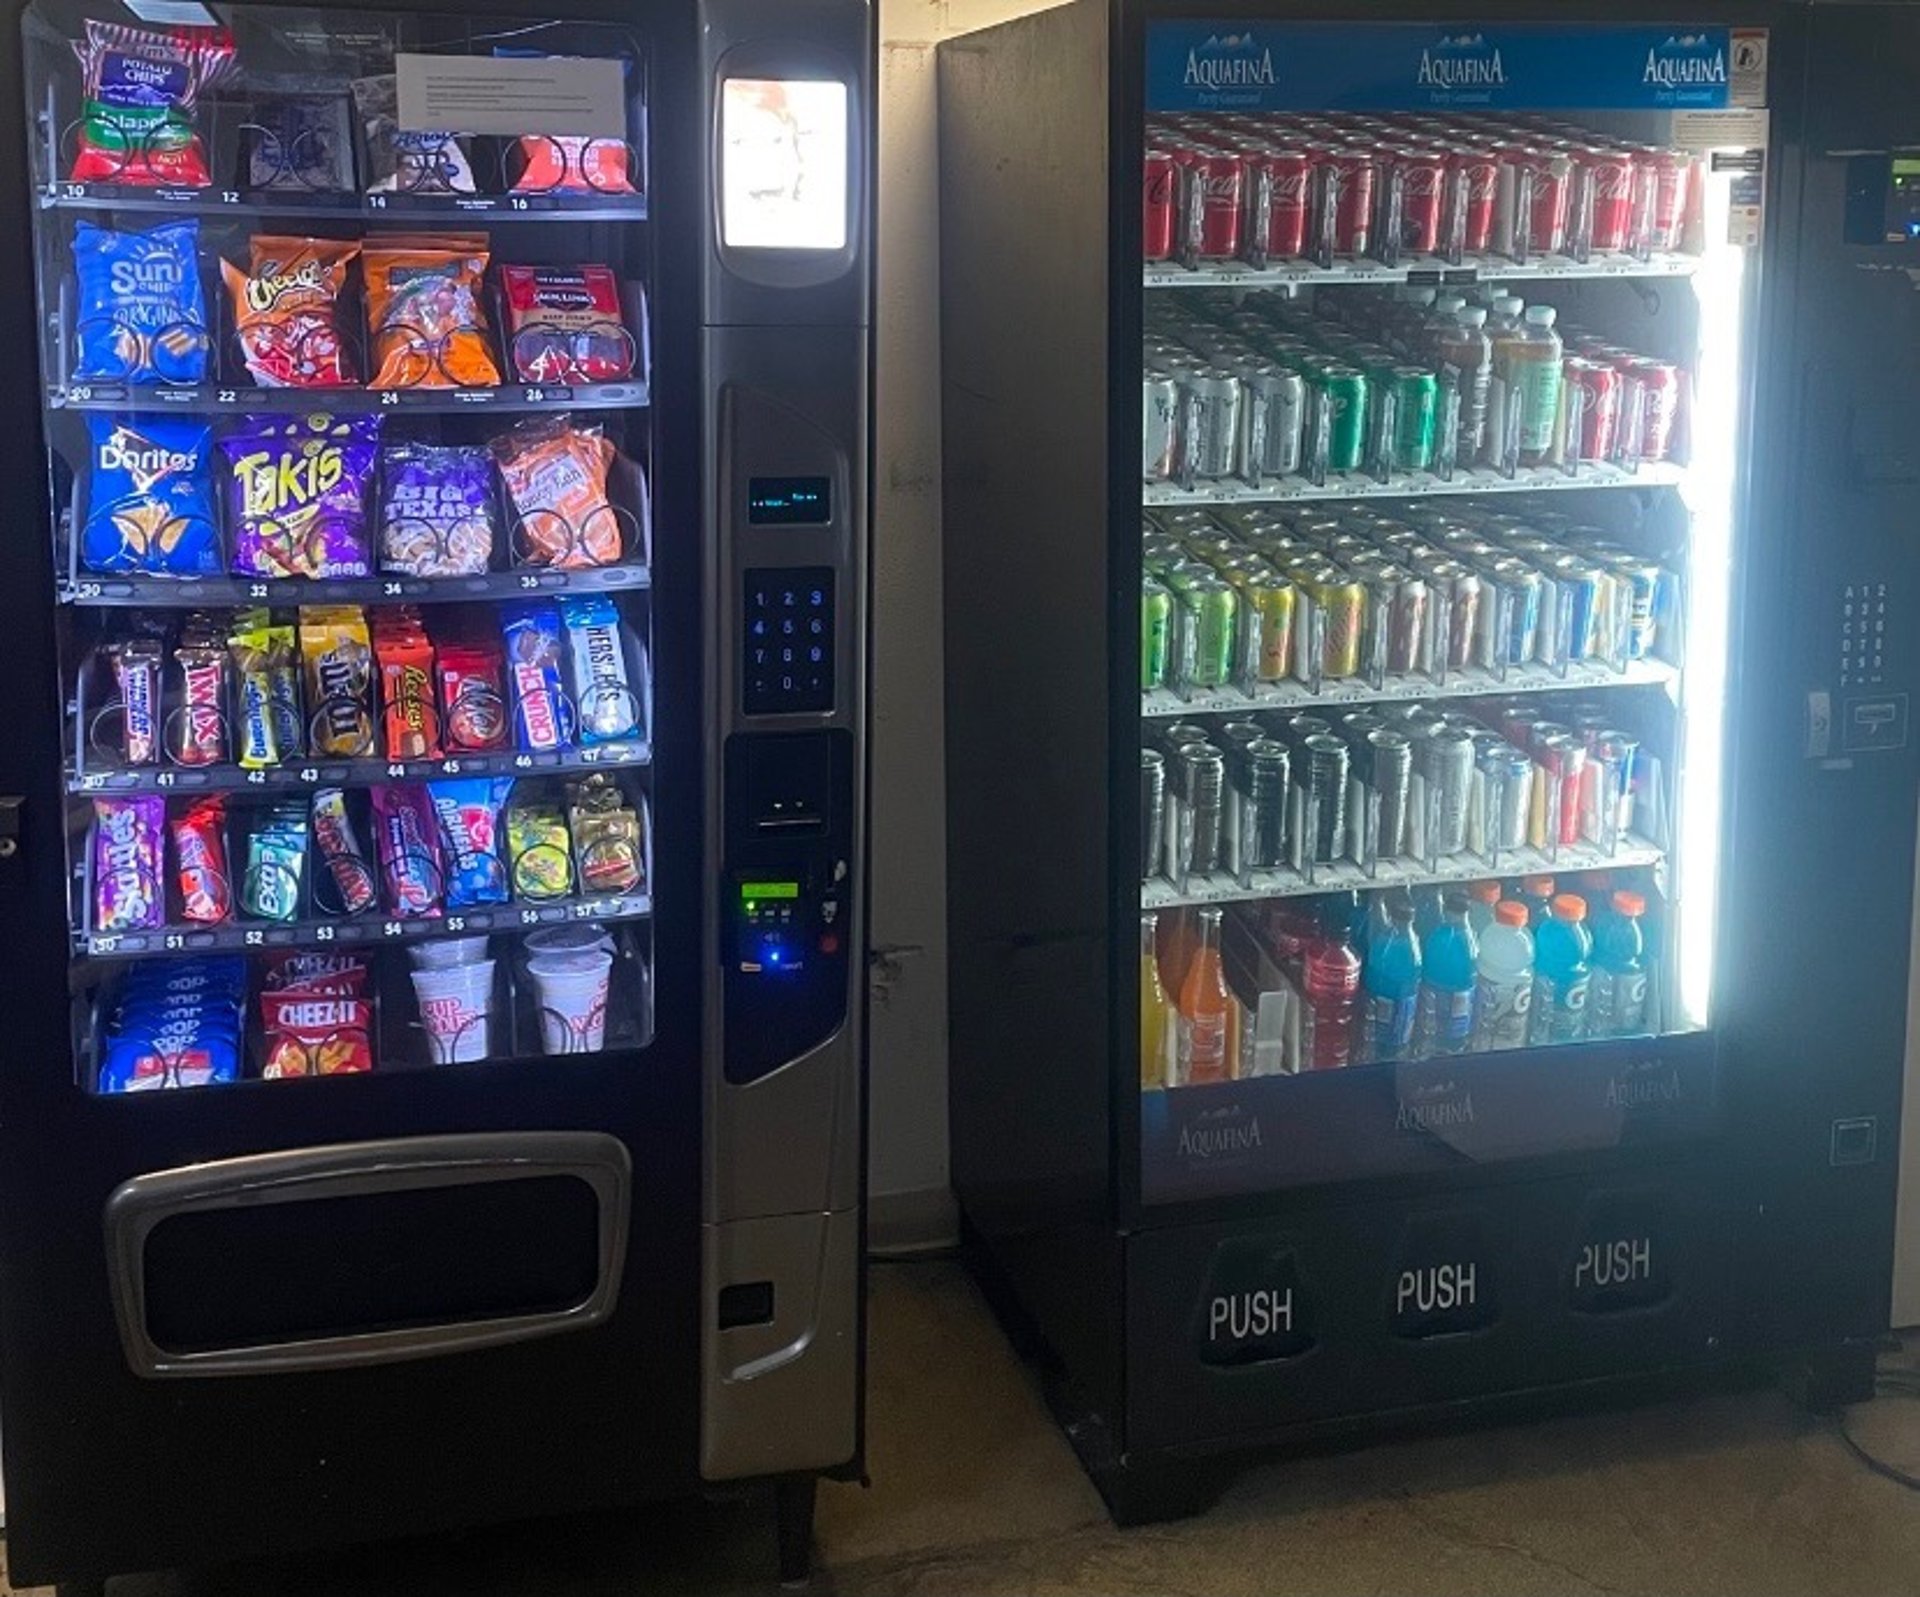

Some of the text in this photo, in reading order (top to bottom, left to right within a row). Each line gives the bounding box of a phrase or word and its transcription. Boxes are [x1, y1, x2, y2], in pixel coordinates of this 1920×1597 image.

[1184, 48, 1275, 90] AQUAFINA
[1417, 49, 1504, 89] AQUAFINA
[1643, 48, 1726, 88] AQUAFINA
[66, 184, 85, 197] 10
[222, 191, 240, 203] 12
[511, 198, 528, 210] 16
[71, 387, 91, 400] 20
[219, 391, 236, 402] 22
[382, 393, 398, 405] 24
[527, 389, 543, 401] 26
[101, 446, 198, 472] Doritos
[234, 446, 343, 516] Takis
[393, 485, 463, 501] BIG
[385, 502, 474, 519] TEXAS
[384, 583, 402, 595] 34
[521, 577, 539, 588] 36
[250, 585, 267, 597] 32
[1845, 586, 1854, 598] A
[1877, 584, 1886, 596] 2
[755, 591, 822, 606] 1 2 3
[754, 620, 821, 634] 4 5 6
[756, 648, 821, 663] 7 8 9
[783, 677, 792, 689] 0
[187, 666, 221, 744] TWIX
[517, 664, 554, 744] CRUNCH
[442, 760, 460, 773] 45
[516, 755, 532, 768] 46
[248, 771, 266, 783] 42
[300, 769, 318, 781] 43
[387, 765, 405, 777] 44
[157, 773, 175, 786] 41
[521, 910, 539, 923] 56
[384, 922, 402, 935] 54
[447, 917, 465, 930] 55
[245, 932, 263, 945] 52
[316, 927, 333, 940] 53
[166, 935, 184, 948] 51
[1514, 987, 1532, 1014] G
[1565, 984, 1588, 1010] G
[1177, 1117, 1262, 1158] AQUAFINA
[1575, 1237, 1651, 1288] PUSH
[1397, 1262, 1477, 1314] PUSH
[1209, 1288, 1293, 1342] PUSH
